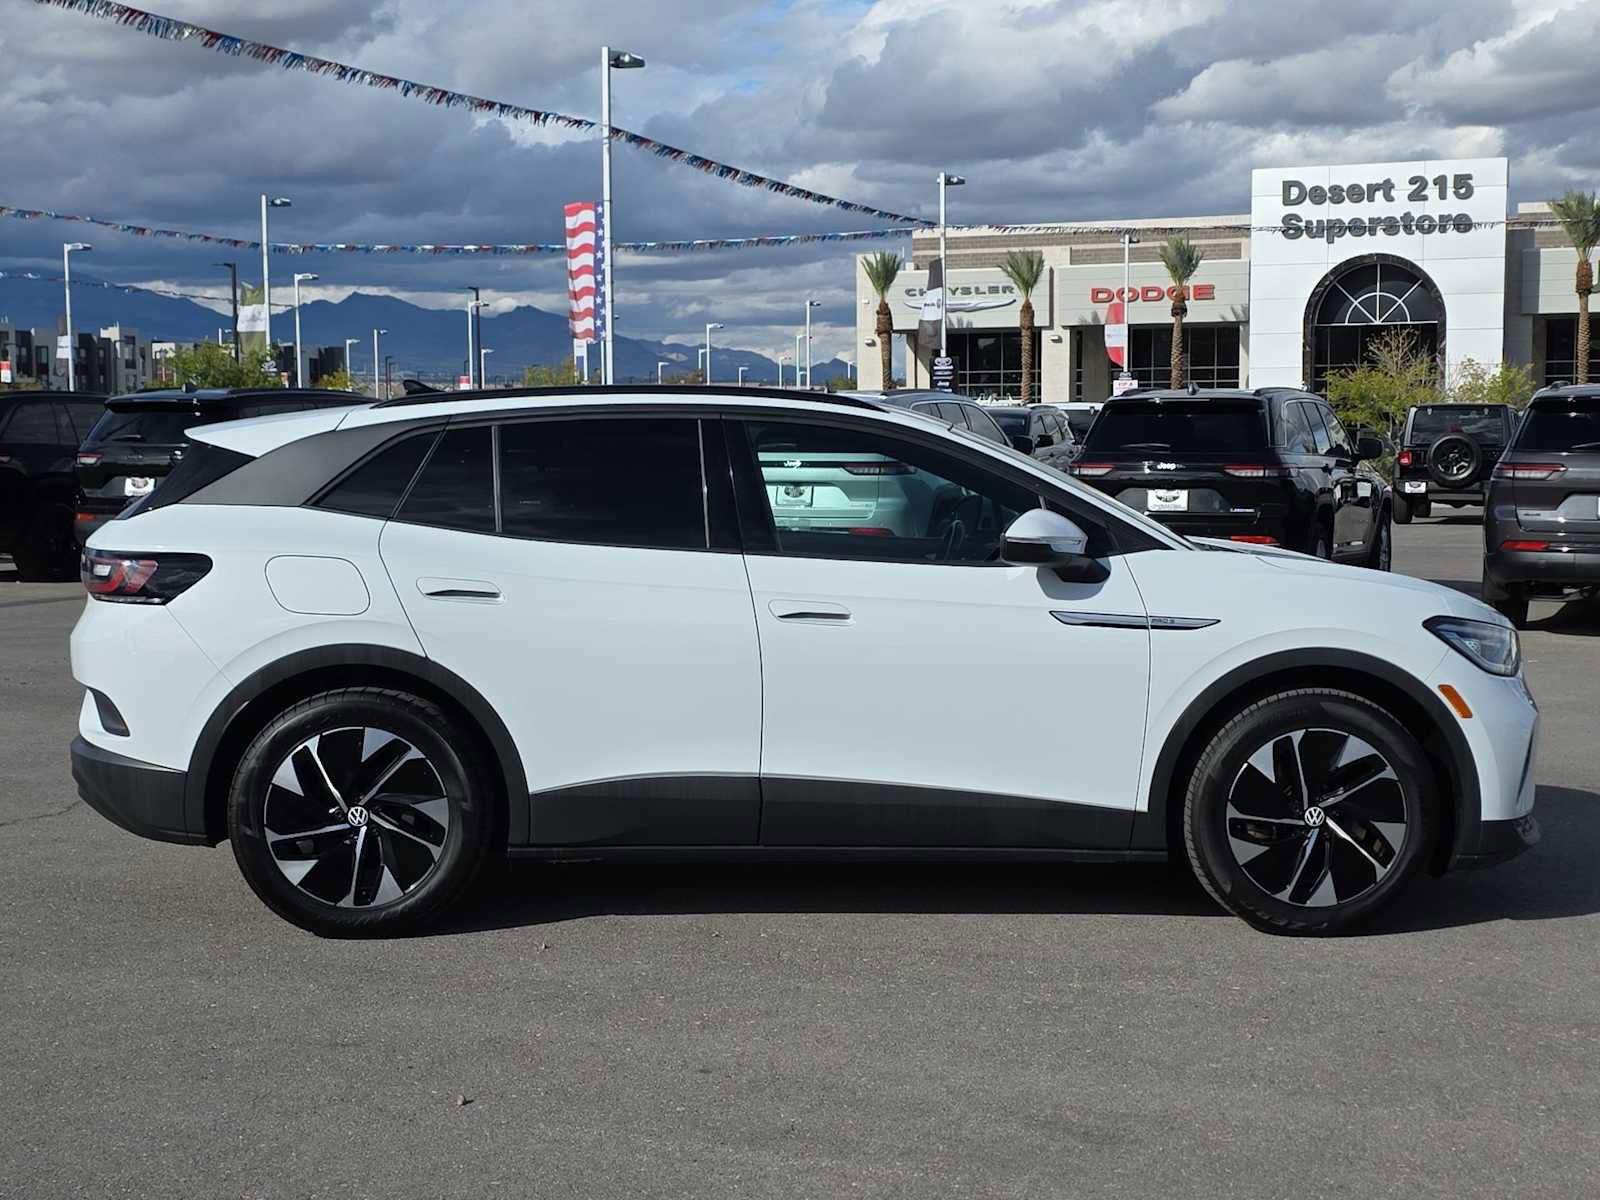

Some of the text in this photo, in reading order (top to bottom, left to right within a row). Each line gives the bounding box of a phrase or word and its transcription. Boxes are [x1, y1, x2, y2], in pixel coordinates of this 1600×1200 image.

[1282, 173, 1475, 206] Desert 215
[1281, 211, 1474, 244] Superstore
[904, 285, 1015, 297] CHYSLER
[1090, 284, 1216, 303] DODGE
[1156, 461, 1177, 470] Jeep
